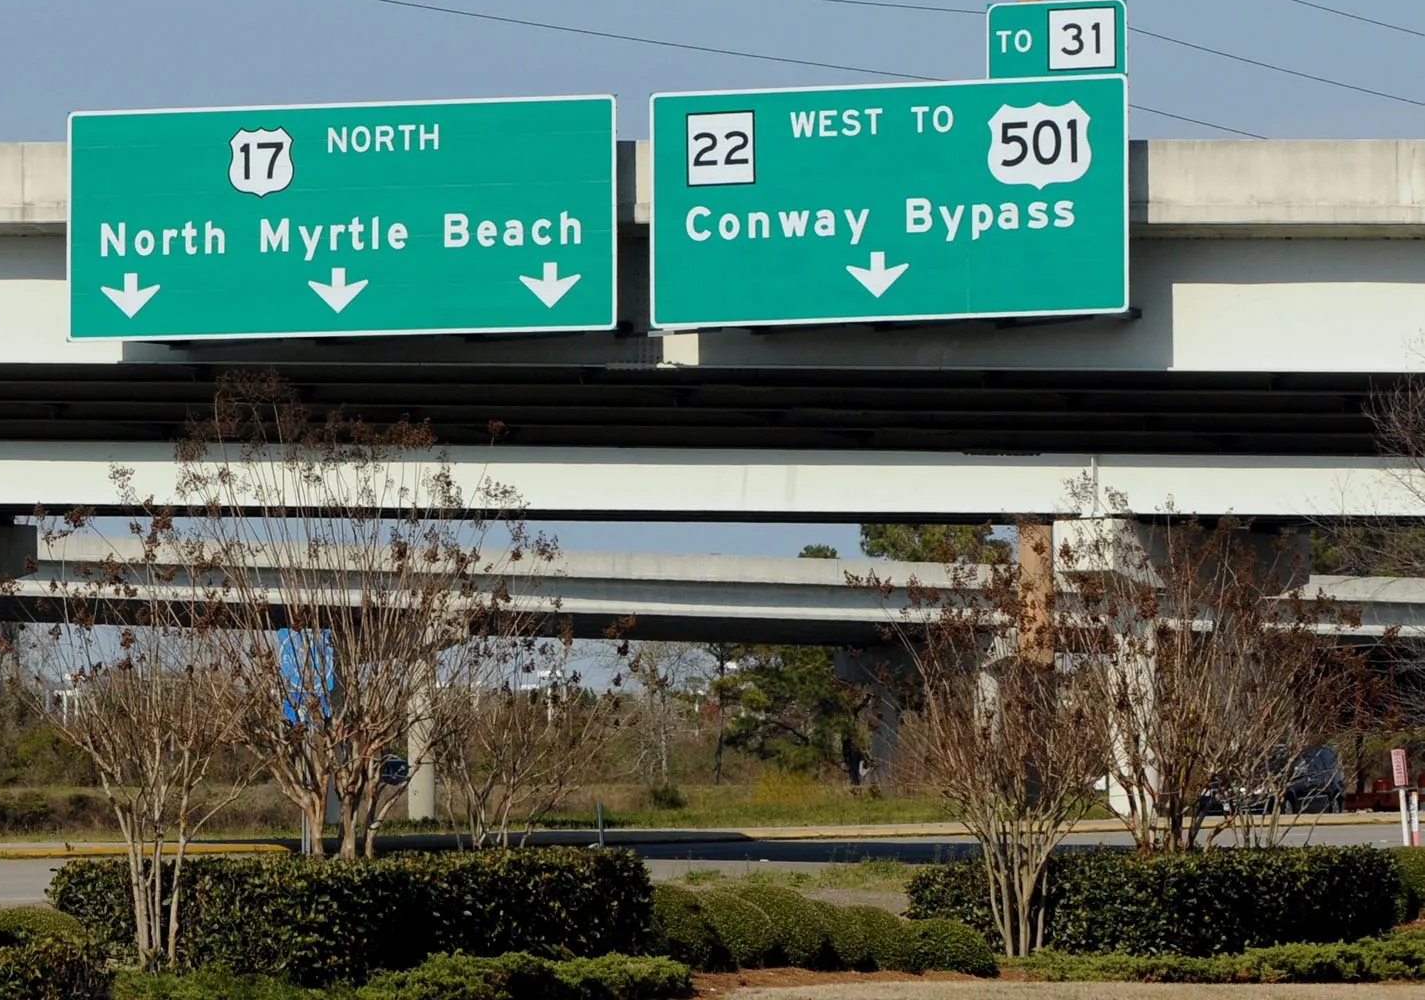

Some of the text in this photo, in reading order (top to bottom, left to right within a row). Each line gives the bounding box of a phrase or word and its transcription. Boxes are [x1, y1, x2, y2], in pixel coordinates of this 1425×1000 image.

[996, 22, 1101, 56] TO 31
[239, 123, 440, 181] 17 NORTH
[692, 105, 1078, 167] 22 WEST TO 501
[100, 211, 582, 261] North Myrtle Beach
[685, 197, 1076, 245] Conway Bypass
